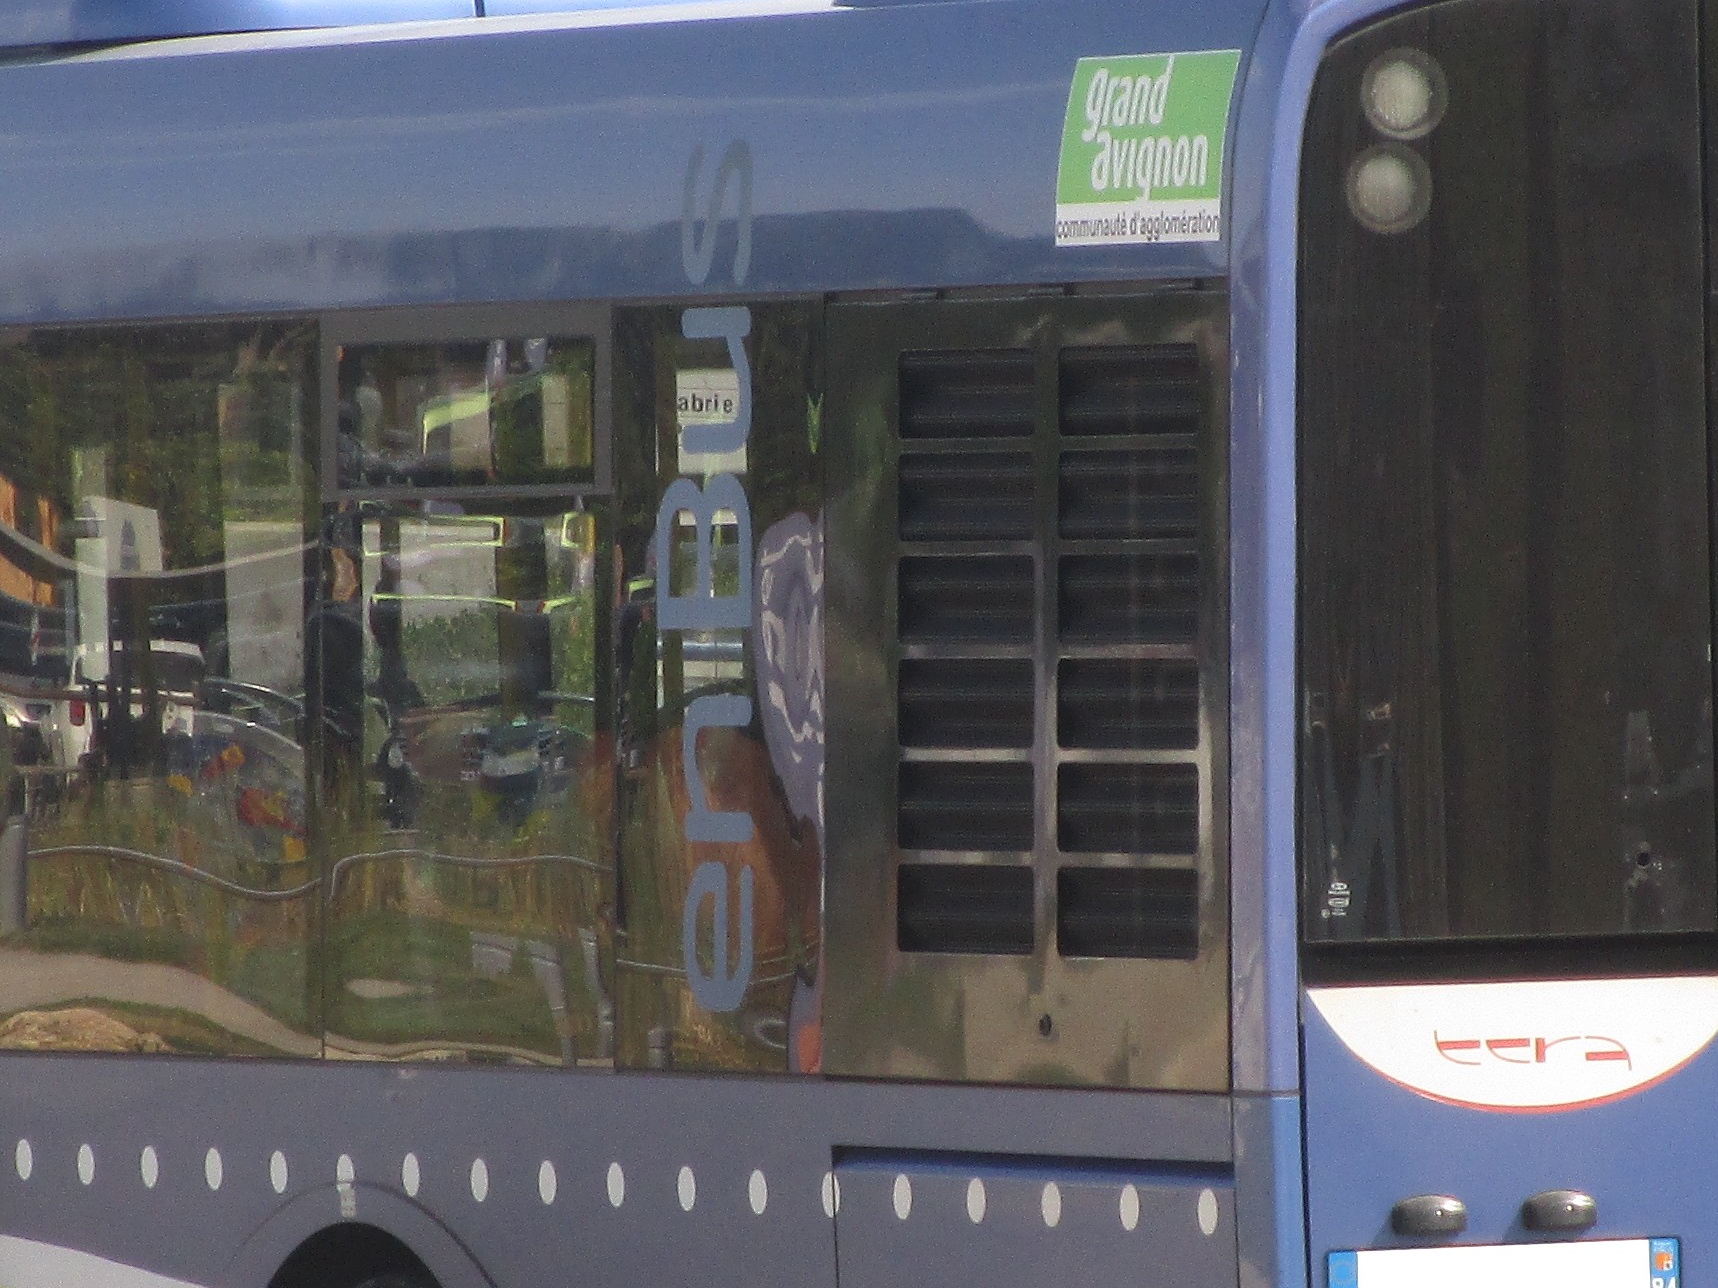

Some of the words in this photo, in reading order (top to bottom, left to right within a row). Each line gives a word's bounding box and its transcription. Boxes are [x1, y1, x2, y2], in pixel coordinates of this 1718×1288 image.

[1082, 54, 1175, 143] grand
[1091, 130, 1209, 202] avignon
[1057, 214, 1127, 240] communauté
[1129, 210, 1220, 241] d'agglomération
